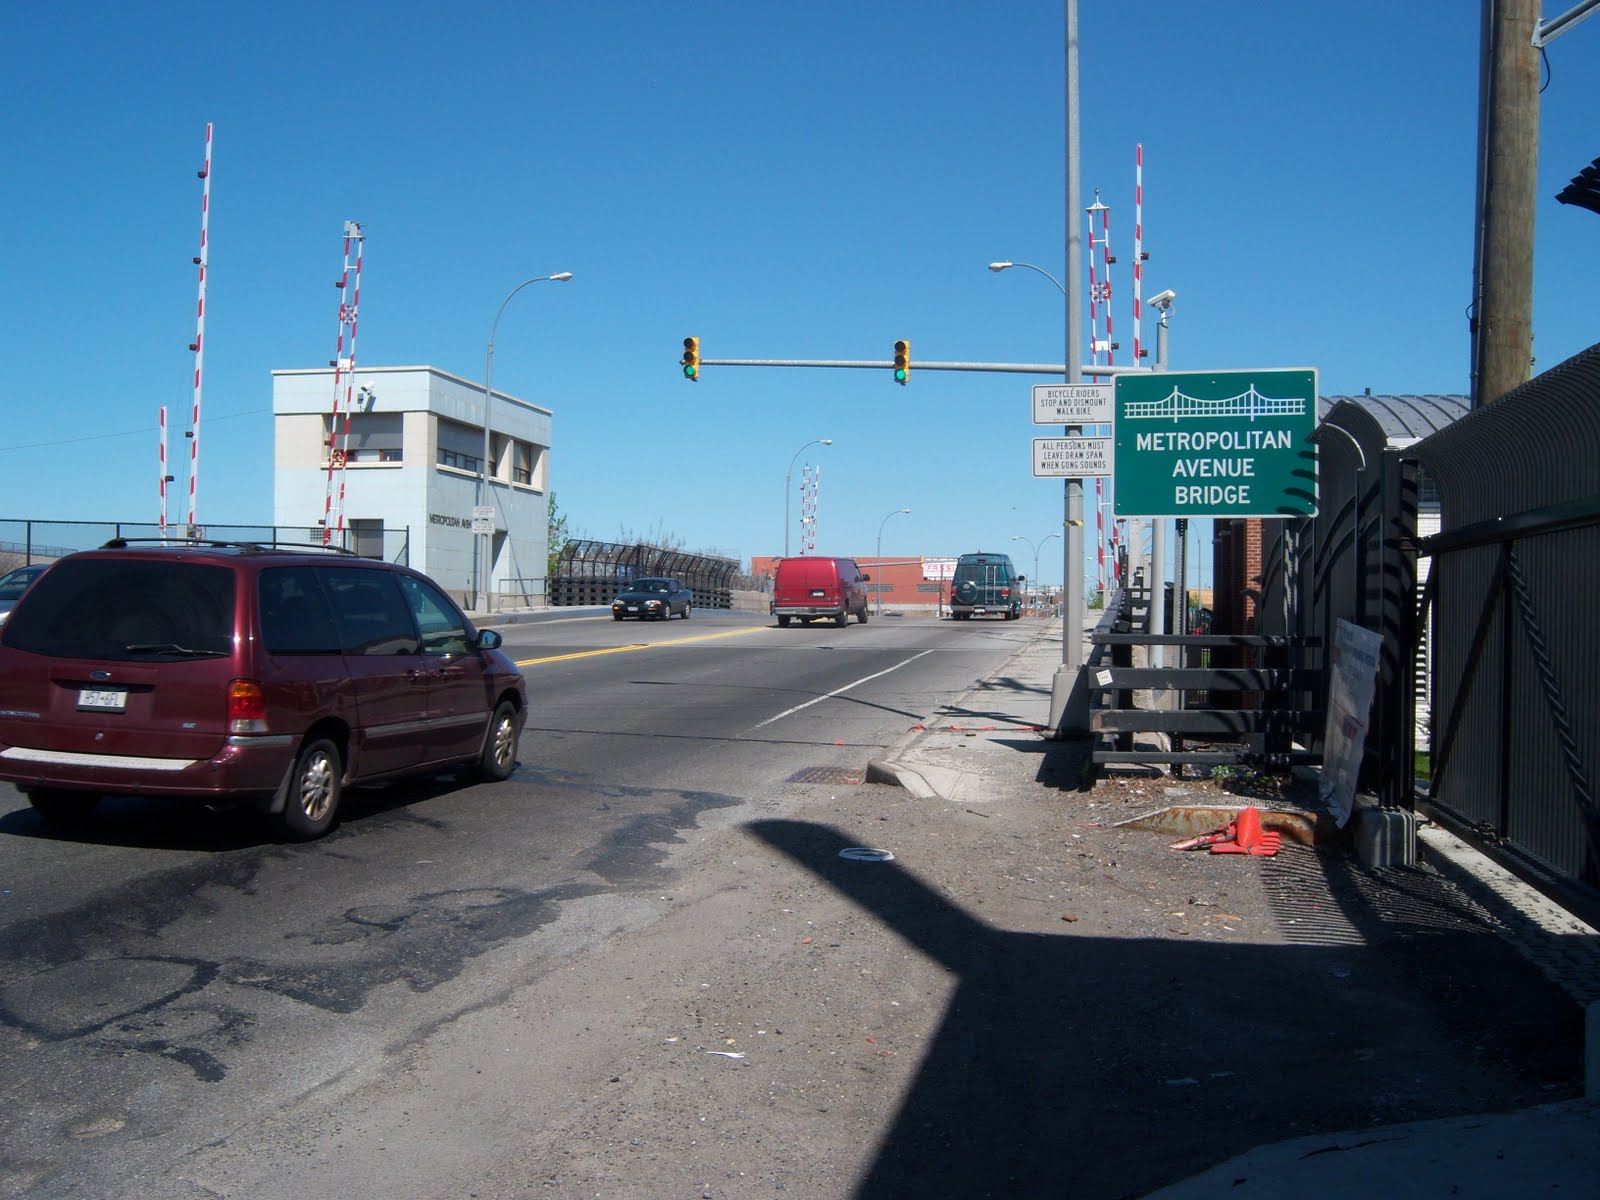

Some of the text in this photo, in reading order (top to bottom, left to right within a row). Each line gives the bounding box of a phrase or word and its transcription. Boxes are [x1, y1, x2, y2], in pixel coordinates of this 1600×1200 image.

[1047, 389, 1100, 398] BICYCLE RIDERS
[1040, 398, 1107, 407] STOP AND DISMOUNT
[1056, 407, 1091, 415] WALK BIKE
[1042, 441, 1105, 450] ALL PERSONS MUST
[1136, 430, 1292, 452] METROPOLITAN
[1043, 451, 1103, 460] LEAVE DRAW SPAN
[1041, 460, 1107, 470] WHEN GONG SOUNDS
[1172, 458, 1255, 478] AVENUE
[1174, 485, 1251, 505] BRIDGE
[429, 514, 460, 528] METROPOLITAN
